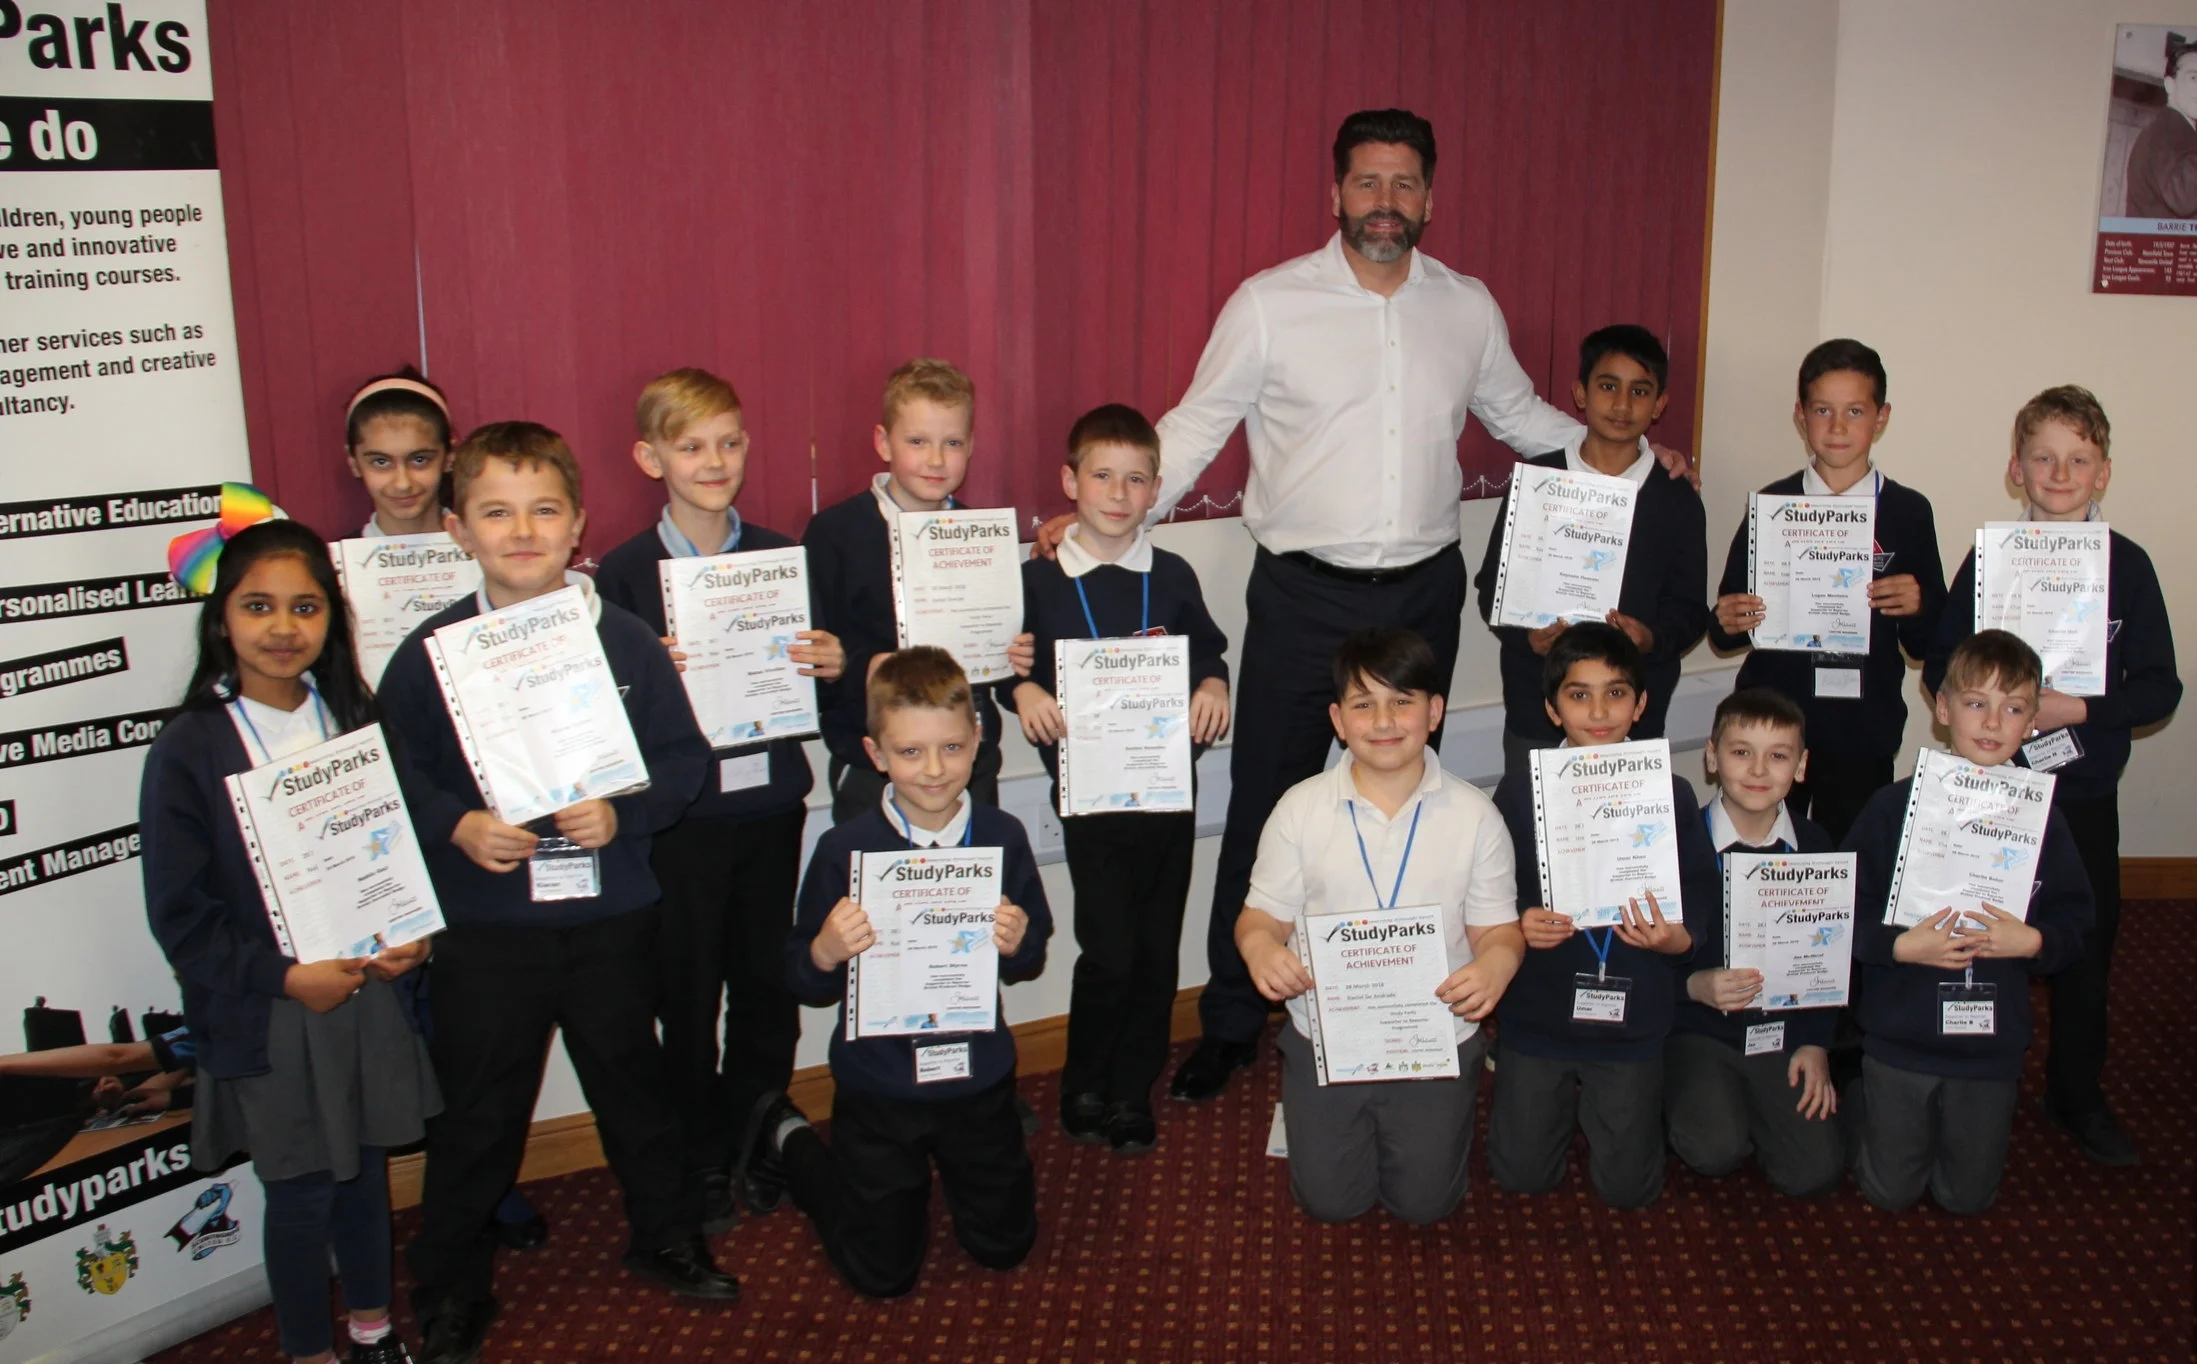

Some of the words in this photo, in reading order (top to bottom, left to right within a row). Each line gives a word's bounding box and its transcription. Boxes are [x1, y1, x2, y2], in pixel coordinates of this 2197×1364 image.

[30, 109, 98, 160] do
[0, 208, 64, 230] ldren,
[70, 205, 133, 229] young
[140, 203, 202, 227] people
[2157, 222, 2186, 231] BARRIE
[27, 238, 65, 258] and
[72, 234, 177, 256] innovative
[5, 269, 89, 291] training
[96, 264, 181, 286] courses.
[37, 329, 123, 351] services
[130, 321, 176, 344] such
[183, 322, 203, 339] as
[0, 360, 91, 388] agement
[97, 353, 134, 377] and
[141, 350, 216, 373] creative
[1548, 482, 1628, 508] StudyParks
[0, 503, 102, 534] ernative
[1543, 503, 1595, 517] CERTIFICATE
[1596, 511, 1608, 519] OF
[1784, 509, 1867, 524] StudyParks
[929, 524, 1010, 541] StudyParks
[1564, 527, 1623, 547] StudyParks
[1782, 529, 1835, 537] CERTIFICATE
[1837, 529, 1849, 537] OF
[929, 546, 982, 557] CERTIFICATE
[983, 545, 995, 554] OF
[2014, 535, 2101, 552] StudyParks
[378, 548, 473, 568] StudyParks
[933, 558, 992, 569] ACHIEVEMENT
[1809, 551, 1869, 562] StudyParks
[704, 564, 798, 589] StudyParks
[2041, 580, 2105, 594] StudyParks
[0, 581, 130, 619] sonalised
[704, 592, 764, 608] CERTIFICATE
[766, 589, 780, 599] OF
[476, 606, 581, 650] StudyParks
[736, 612, 805, 632] StudyParks
[1094, 653, 1180, 670] StudyParks
[0, 648, 122, 696] grammes
[526, 656, 602, 689] StudyParks
[1121, 697, 1184, 710] StudyParks
[32, 725, 112, 758] Media
[283, 748, 380, 796] StudyParks
[1572, 755, 1662, 778] StudyParks
[1571, 781, 1630, 795] CERTIFICATE
[1632, 779, 1644, 789] OF
[1953, 772, 2044, 803] StudyParks
[288, 785, 351, 817] CERTIFICATE
[352, 778, 367, 792] OF
[330, 799, 400, 836] StudyParks
[1603, 802, 1669, 820] StudyParks
[1970, 823, 2038, 846] StudyParks
[0, 858, 38, 892] ent
[896, 864, 993, 882] StudyParks
[1760, 867, 1848, 883] StudyParks
[892, 888, 955, 899] CERTIFICATE
[958, 887, 971, 896] OF
[1758, 888, 1814, 897] CERTIFICATE
[1816, 887, 1829, 895] OF
[1761, 899, 1825, 908] ACHIEVEMENT
[923, 912, 995, 926] StudyParks
[1786, 911, 1850, 925] StudyParks
[1341, 922, 1435, 942] StudyParks
[1341, 946, 1401, 958] CERTIFICATE
[1403, 944, 1417, 953] OF
[1346, 957, 1414, 970] ACHIEVEMENT
[1587, 992, 1624, 1000] StudyParks
